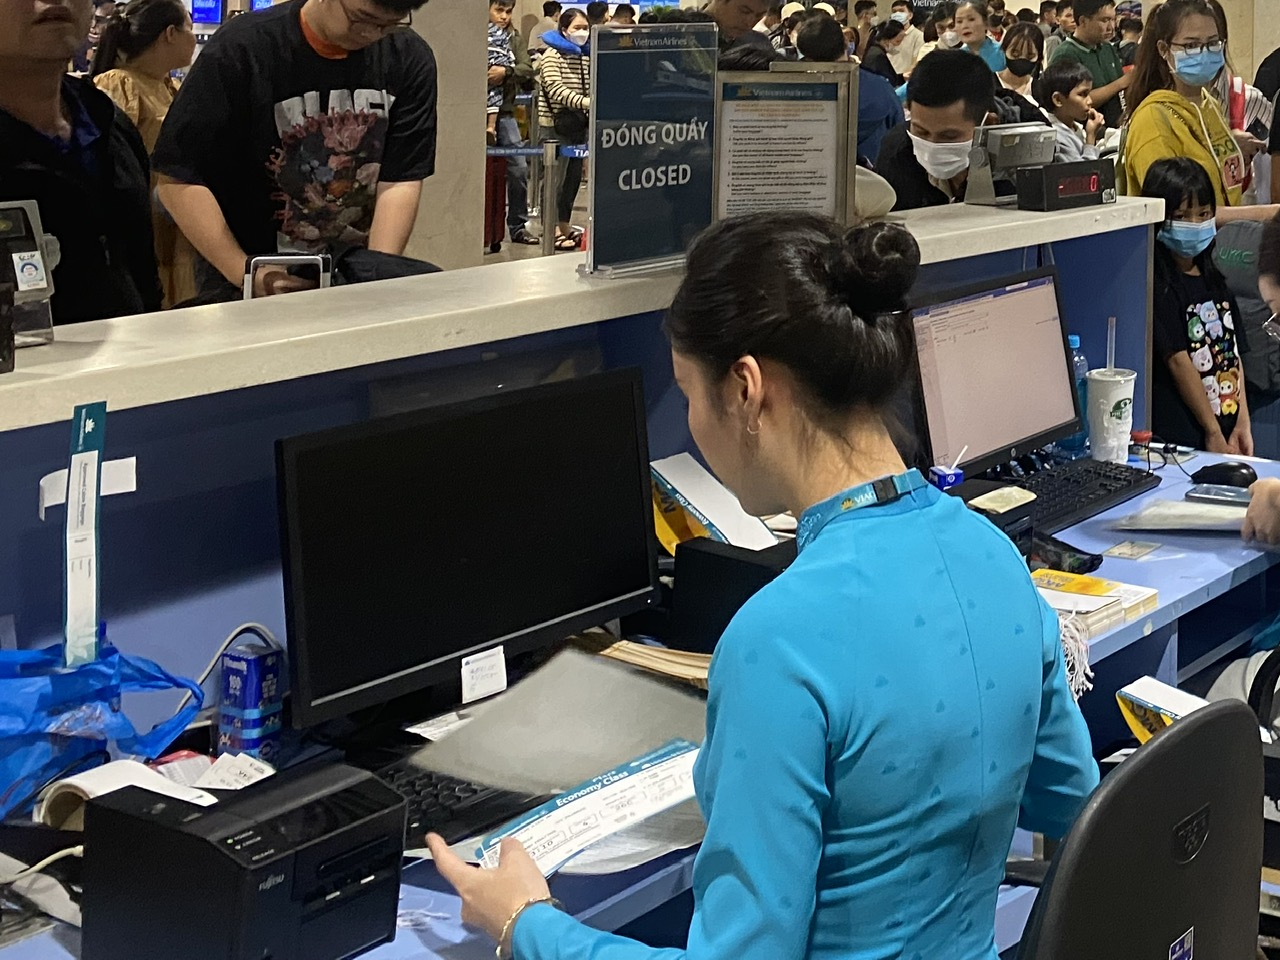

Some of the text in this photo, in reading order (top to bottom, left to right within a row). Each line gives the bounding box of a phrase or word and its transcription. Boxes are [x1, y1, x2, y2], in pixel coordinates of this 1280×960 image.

[601, 123, 657, 149] ĐÓNG
[618, 164, 692, 191] CLOSED
[555, 783, 602, 807] Economy
[603, 771, 629, 786] Class
